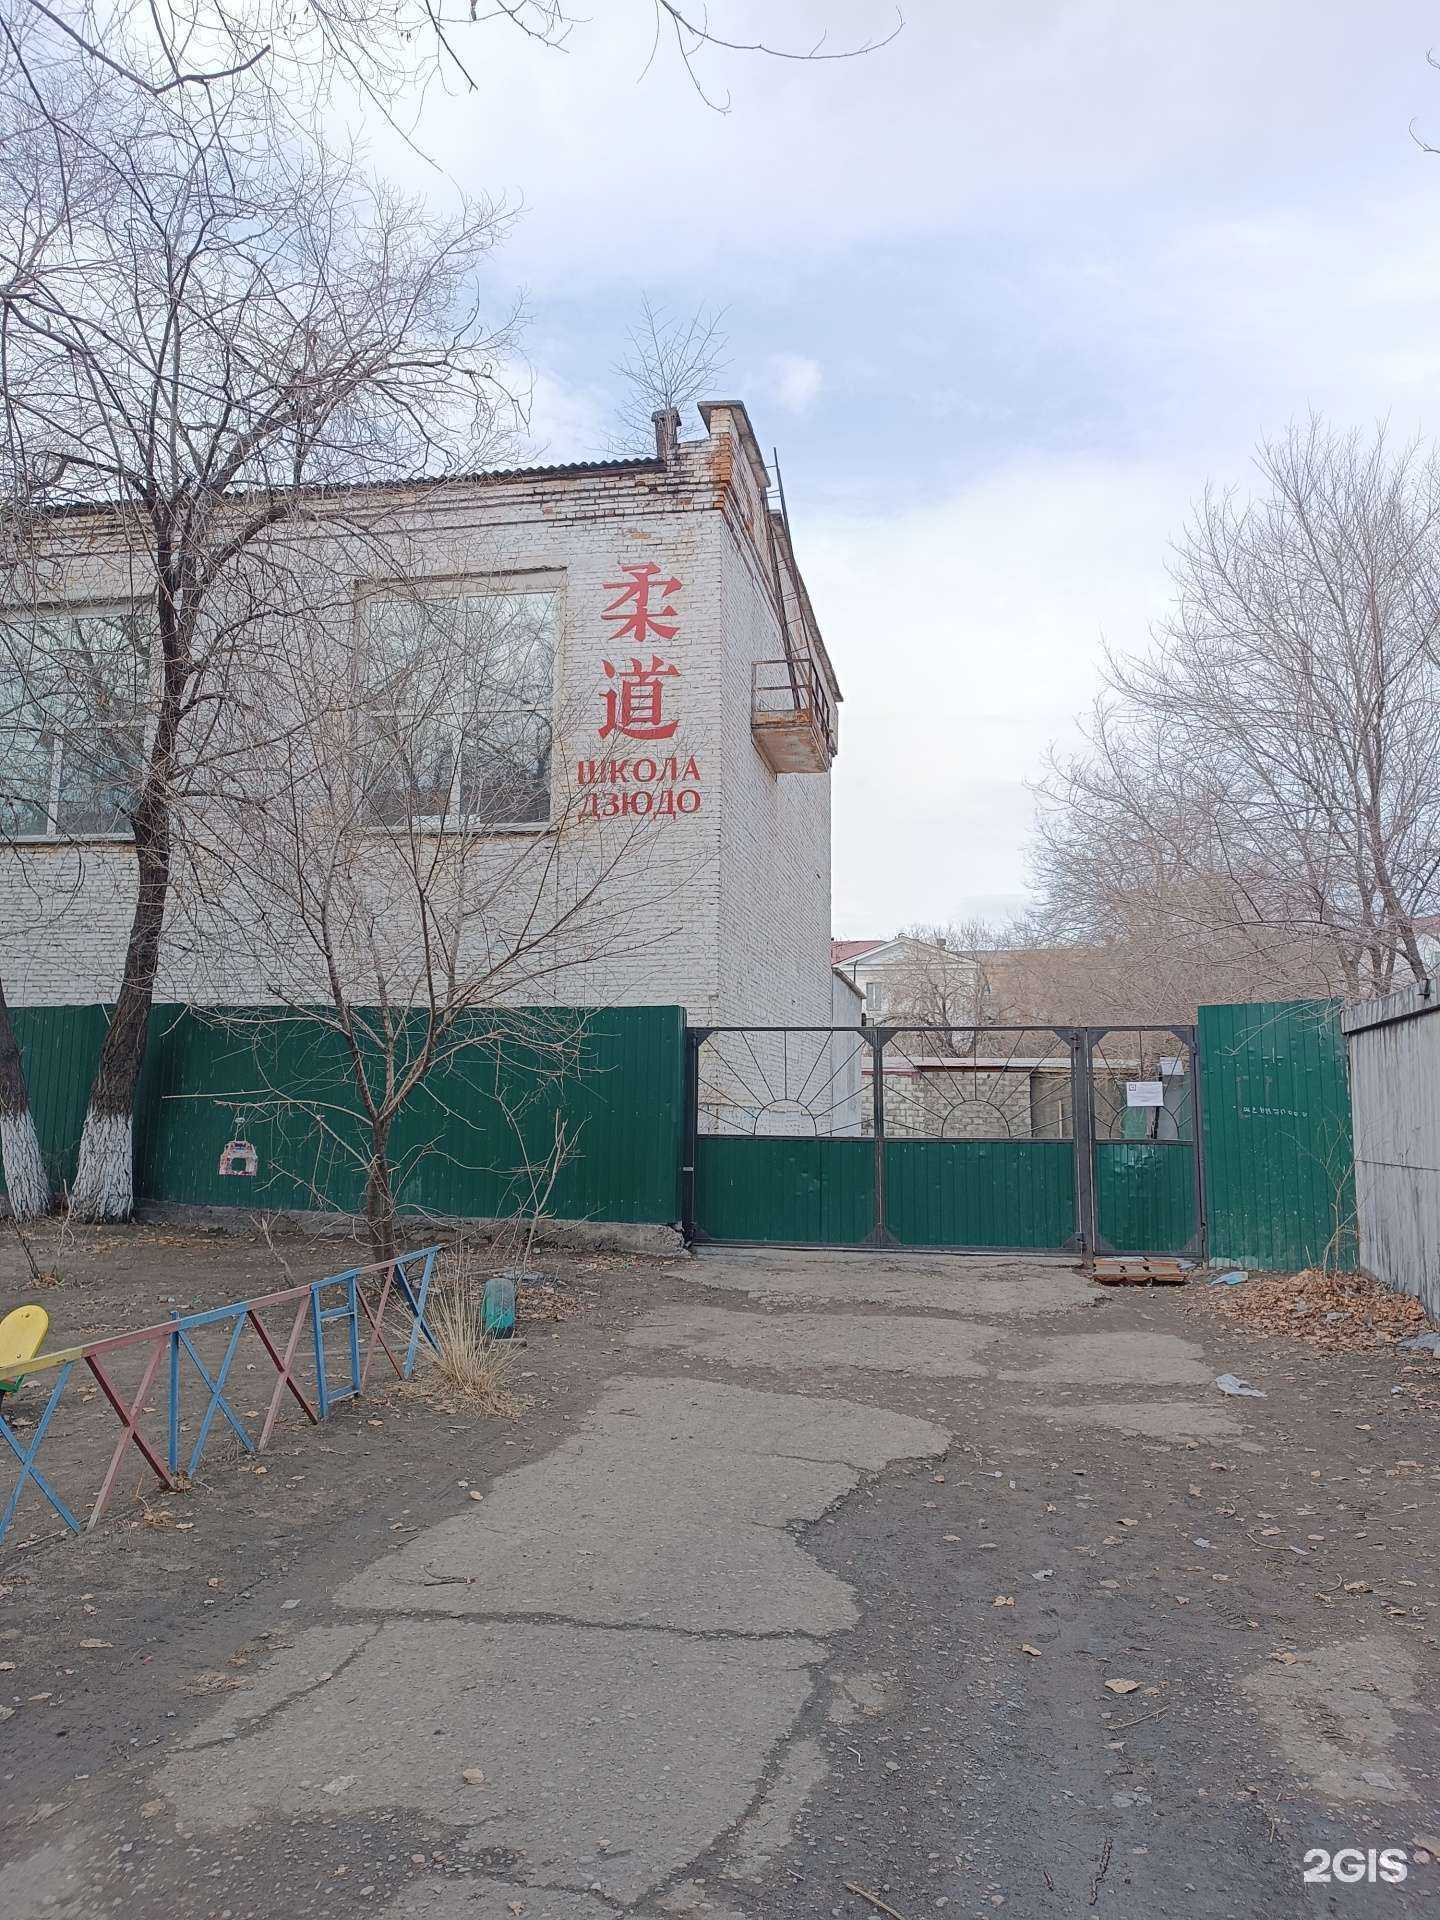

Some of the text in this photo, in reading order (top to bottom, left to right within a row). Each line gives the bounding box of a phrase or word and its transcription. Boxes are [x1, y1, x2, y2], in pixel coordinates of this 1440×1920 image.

[598, 561, 683, 740] 柔道
[577, 754, 702, 785] ШКОЛА
[577, 789, 702, 823] ДЗЮДО
